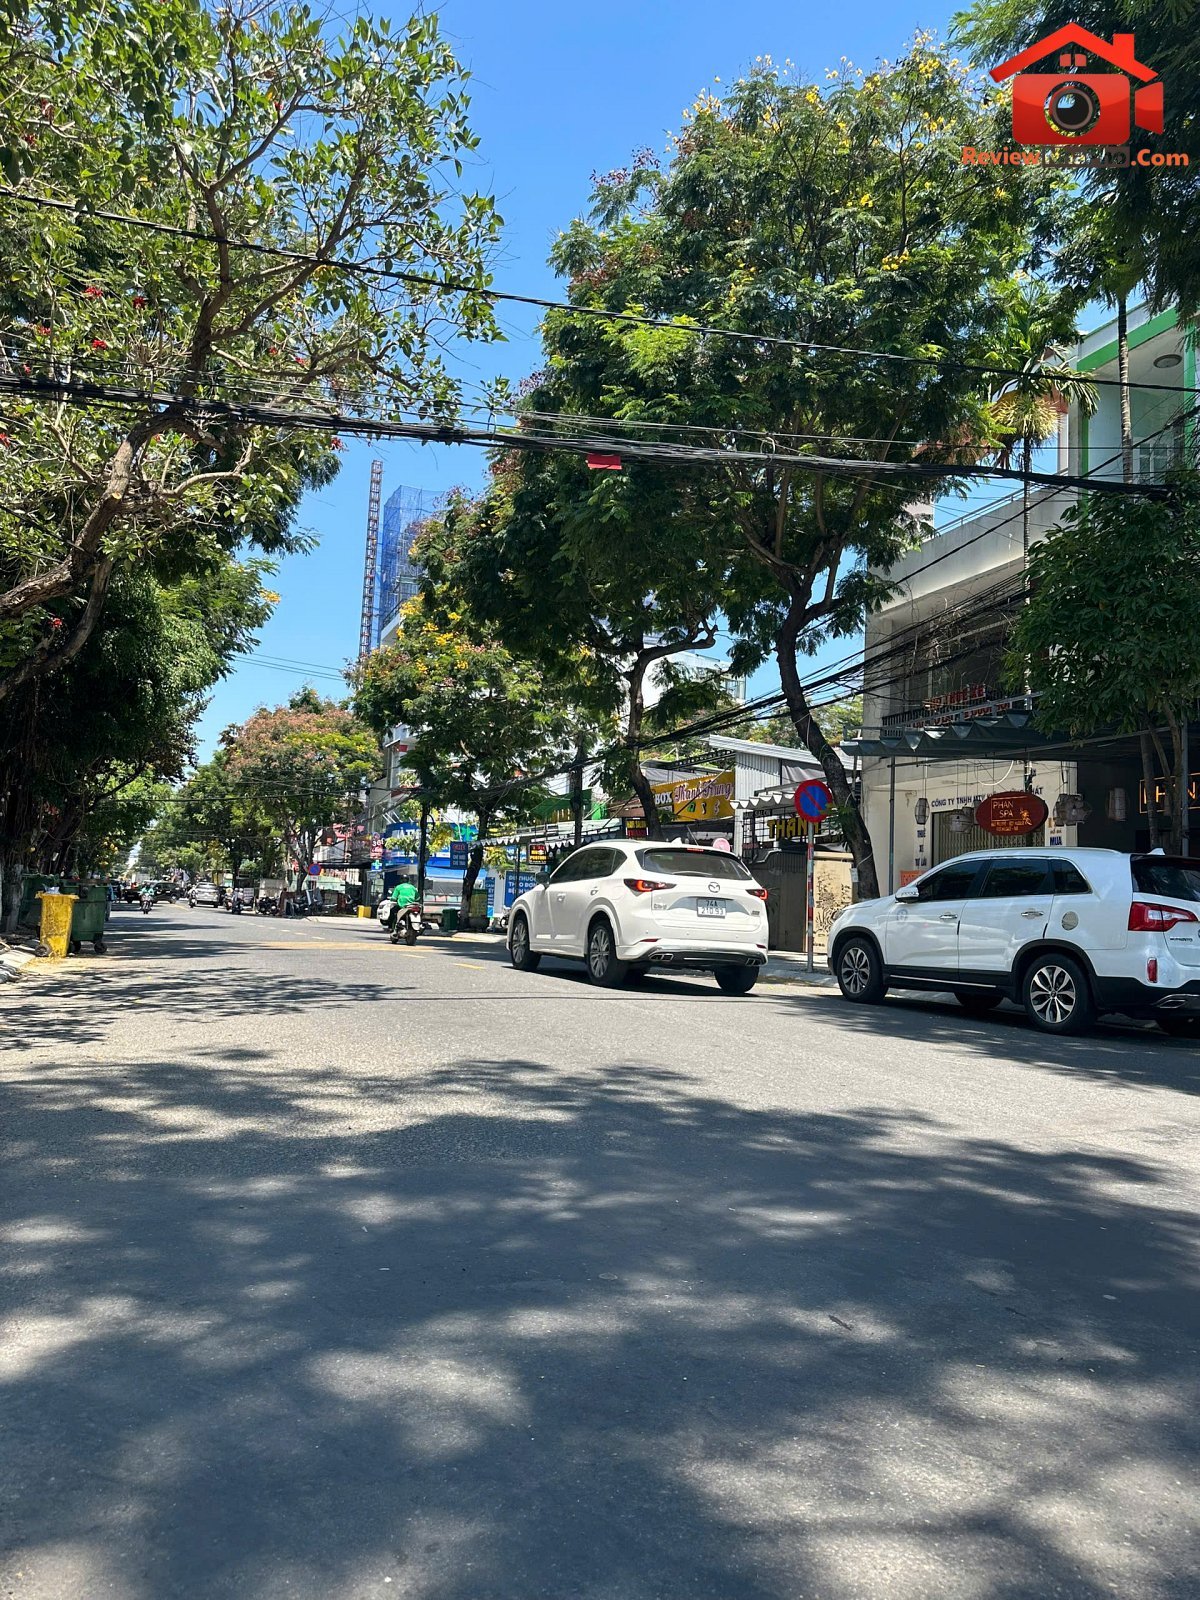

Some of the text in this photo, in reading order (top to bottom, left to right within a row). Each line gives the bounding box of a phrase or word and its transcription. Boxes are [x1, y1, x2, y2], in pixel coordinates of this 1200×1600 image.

[948, 798, 955, 806] TY
[956, 795, 972, 805] TNHH
[992, 800, 1014, 810] PHAN
[1000, 809, 1014, 818] SPA
